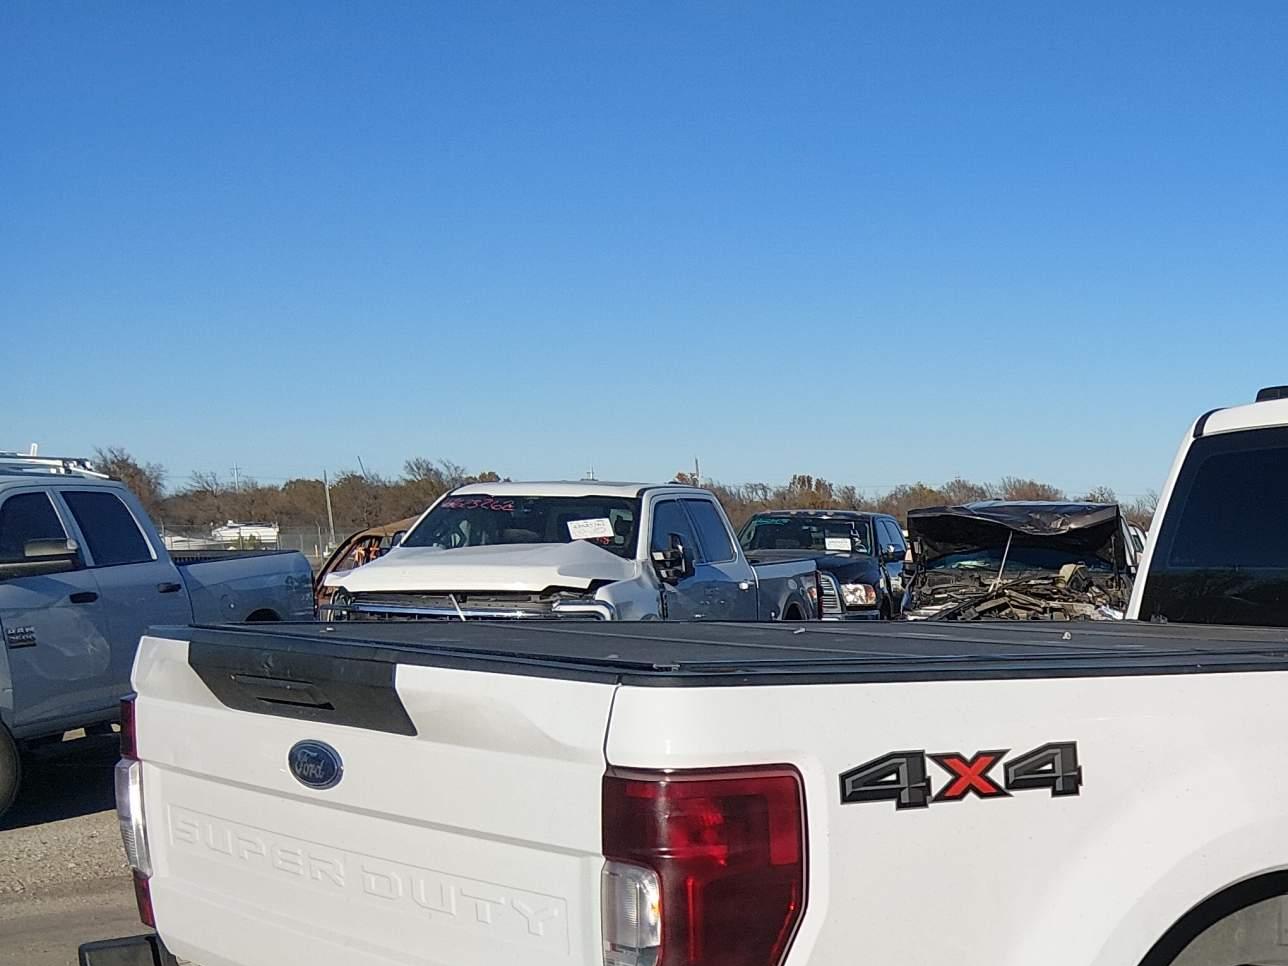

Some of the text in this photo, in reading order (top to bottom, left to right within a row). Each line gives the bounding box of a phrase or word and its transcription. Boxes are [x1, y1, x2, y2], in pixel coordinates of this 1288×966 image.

[294, 748, 325, 779] Ford
[175, 809, 559, 938] SUPER DUTY
